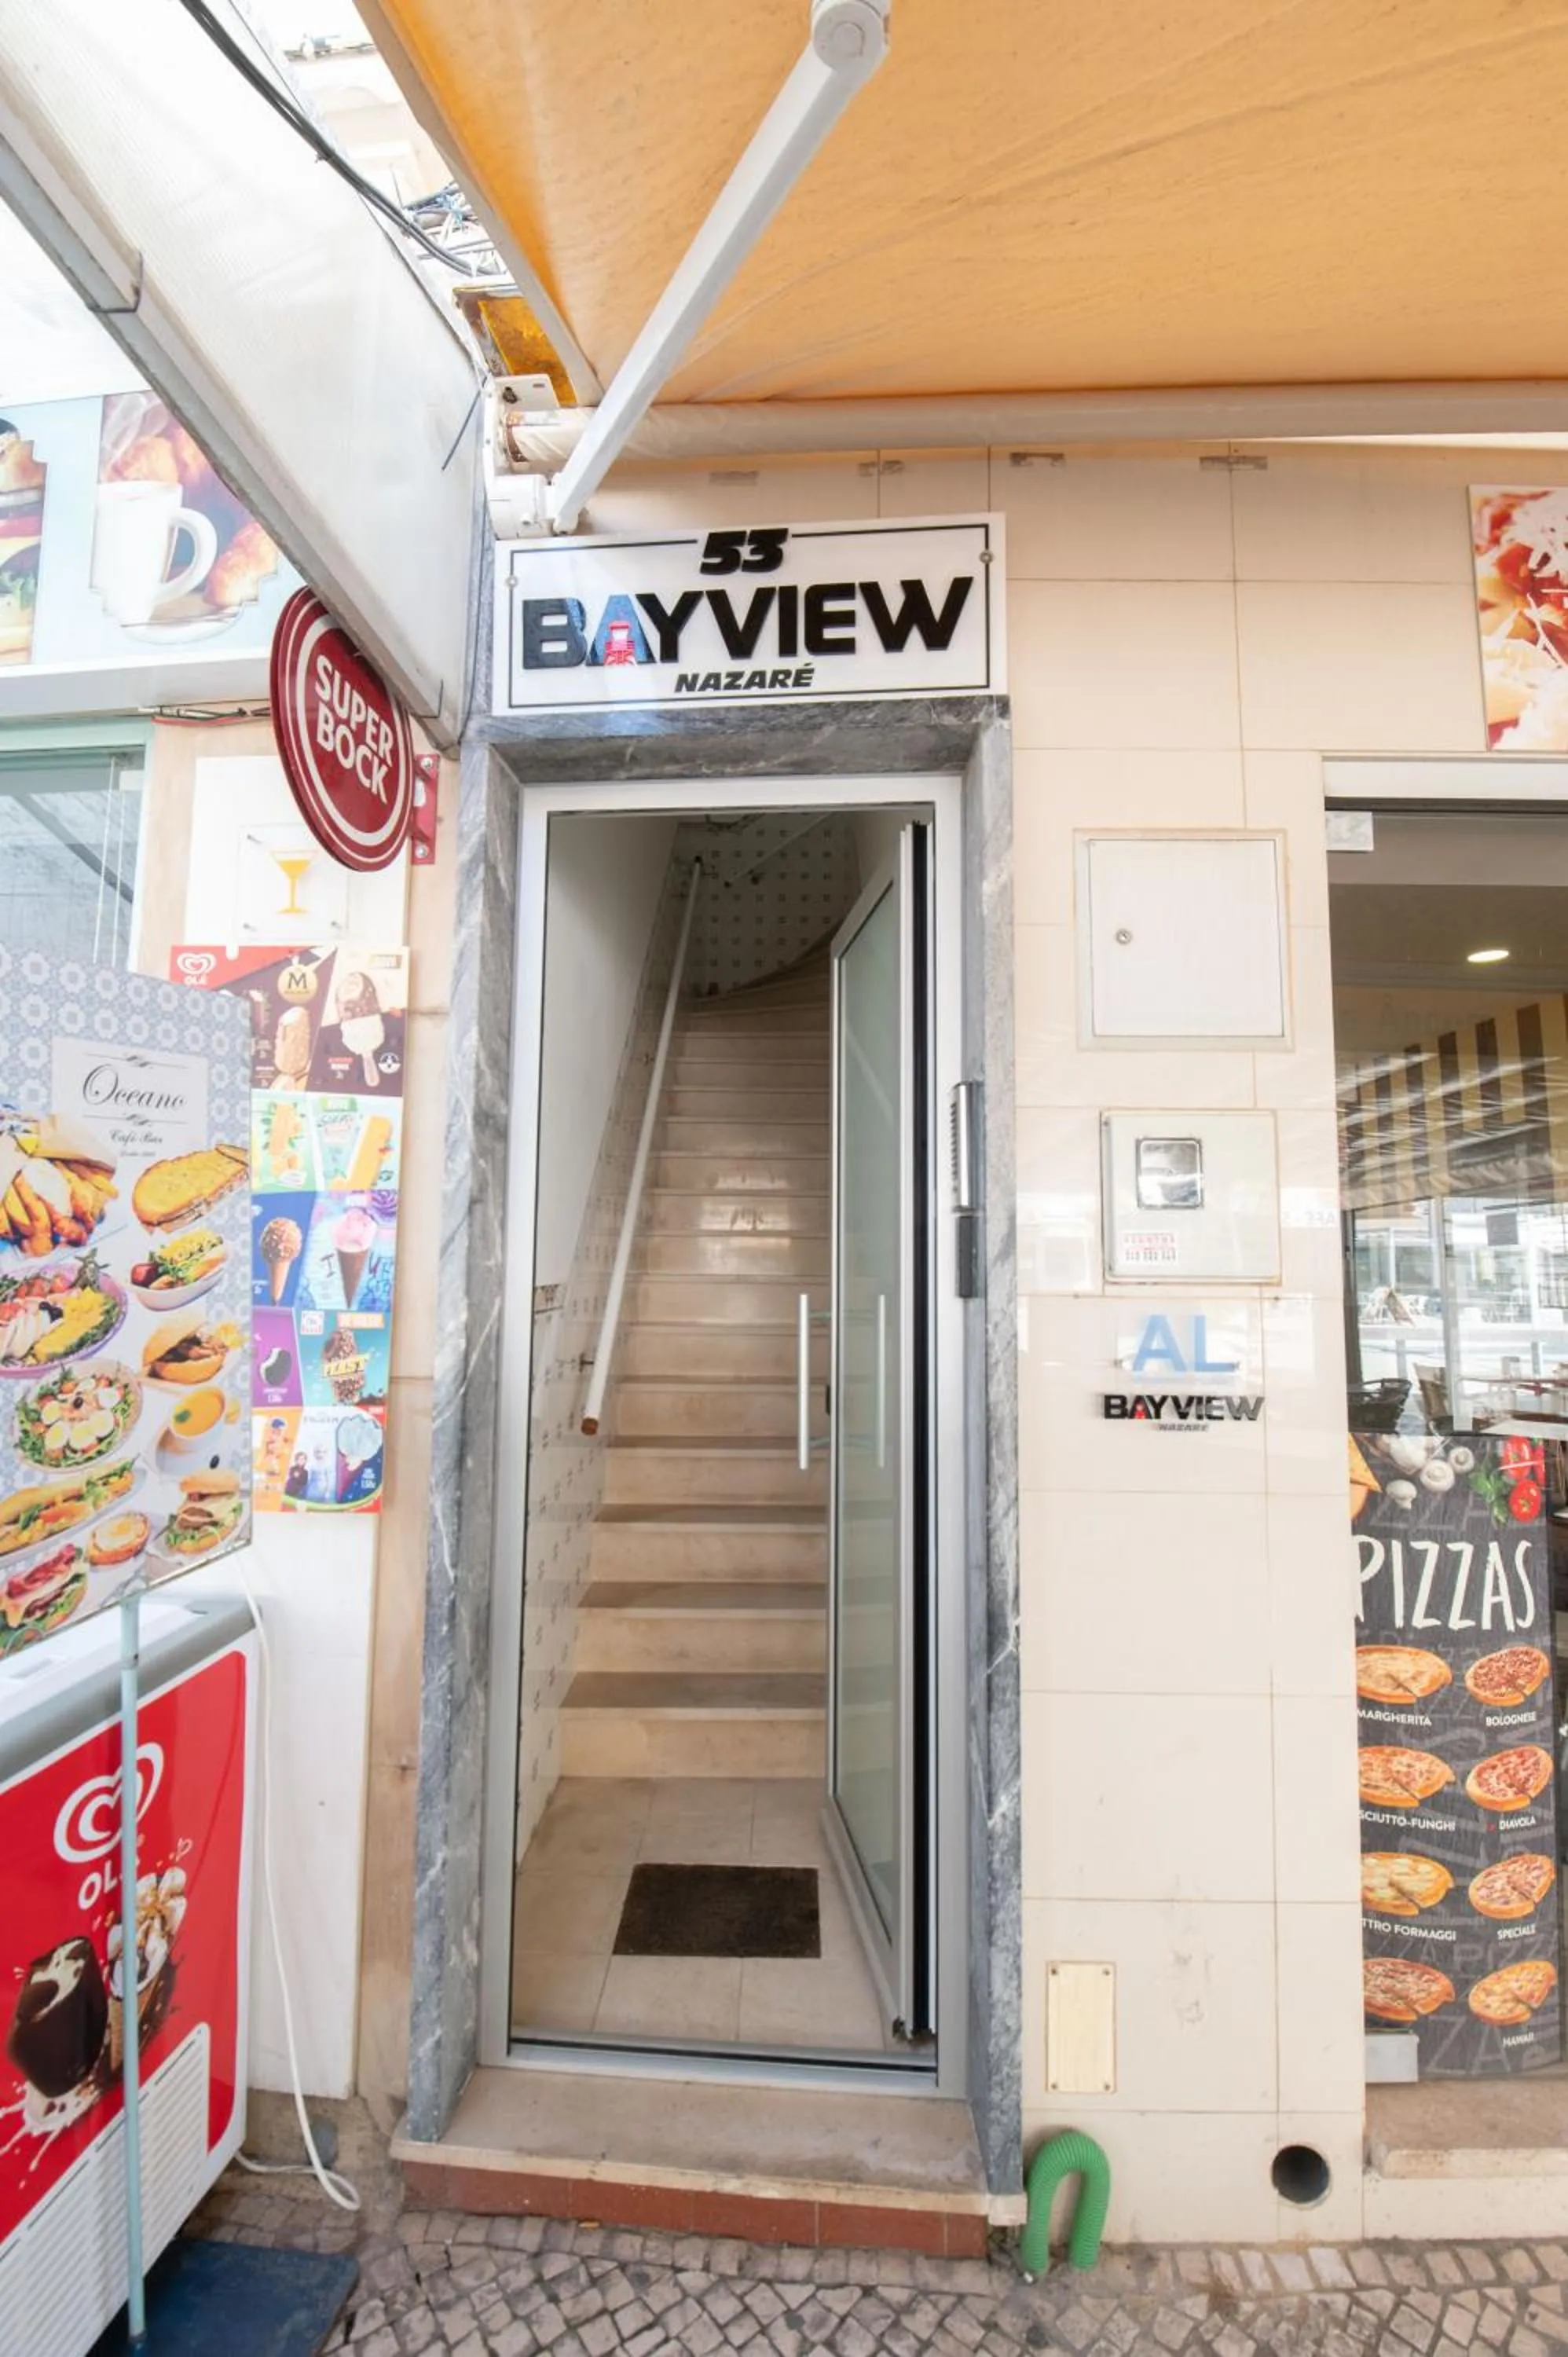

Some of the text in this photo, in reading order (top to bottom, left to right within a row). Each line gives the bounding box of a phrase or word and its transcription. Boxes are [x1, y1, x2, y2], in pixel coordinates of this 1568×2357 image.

[700, 528, 789, 574] 53
[522, 577, 973, 669] BAYVIEW
[674, 663, 815, 693] NAZARÉ
[315, 654, 394, 767] SUPER
[316, 701, 388, 805] BOCK
[82, 1063, 188, 1110] Oceano
[1133, 1314, 1236, 1373] AL
[1104, 1395, 1265, 1421] BAYVIEW
[1352, 1534, 1536, 1632] PIZZAS
[1357, 1710, 1432, 1727] MARGHERITA
[1486, 1711, 1537, 1727] BOLOGNESE
[1499, 1816, 1536, 1831] DIAVOLA
[78, 1858, 139, 1911] OL
[1394, 1924, 1457, 1941] FORMAGGI
[1497, 1923, 1537, 1941] SPECIALE
